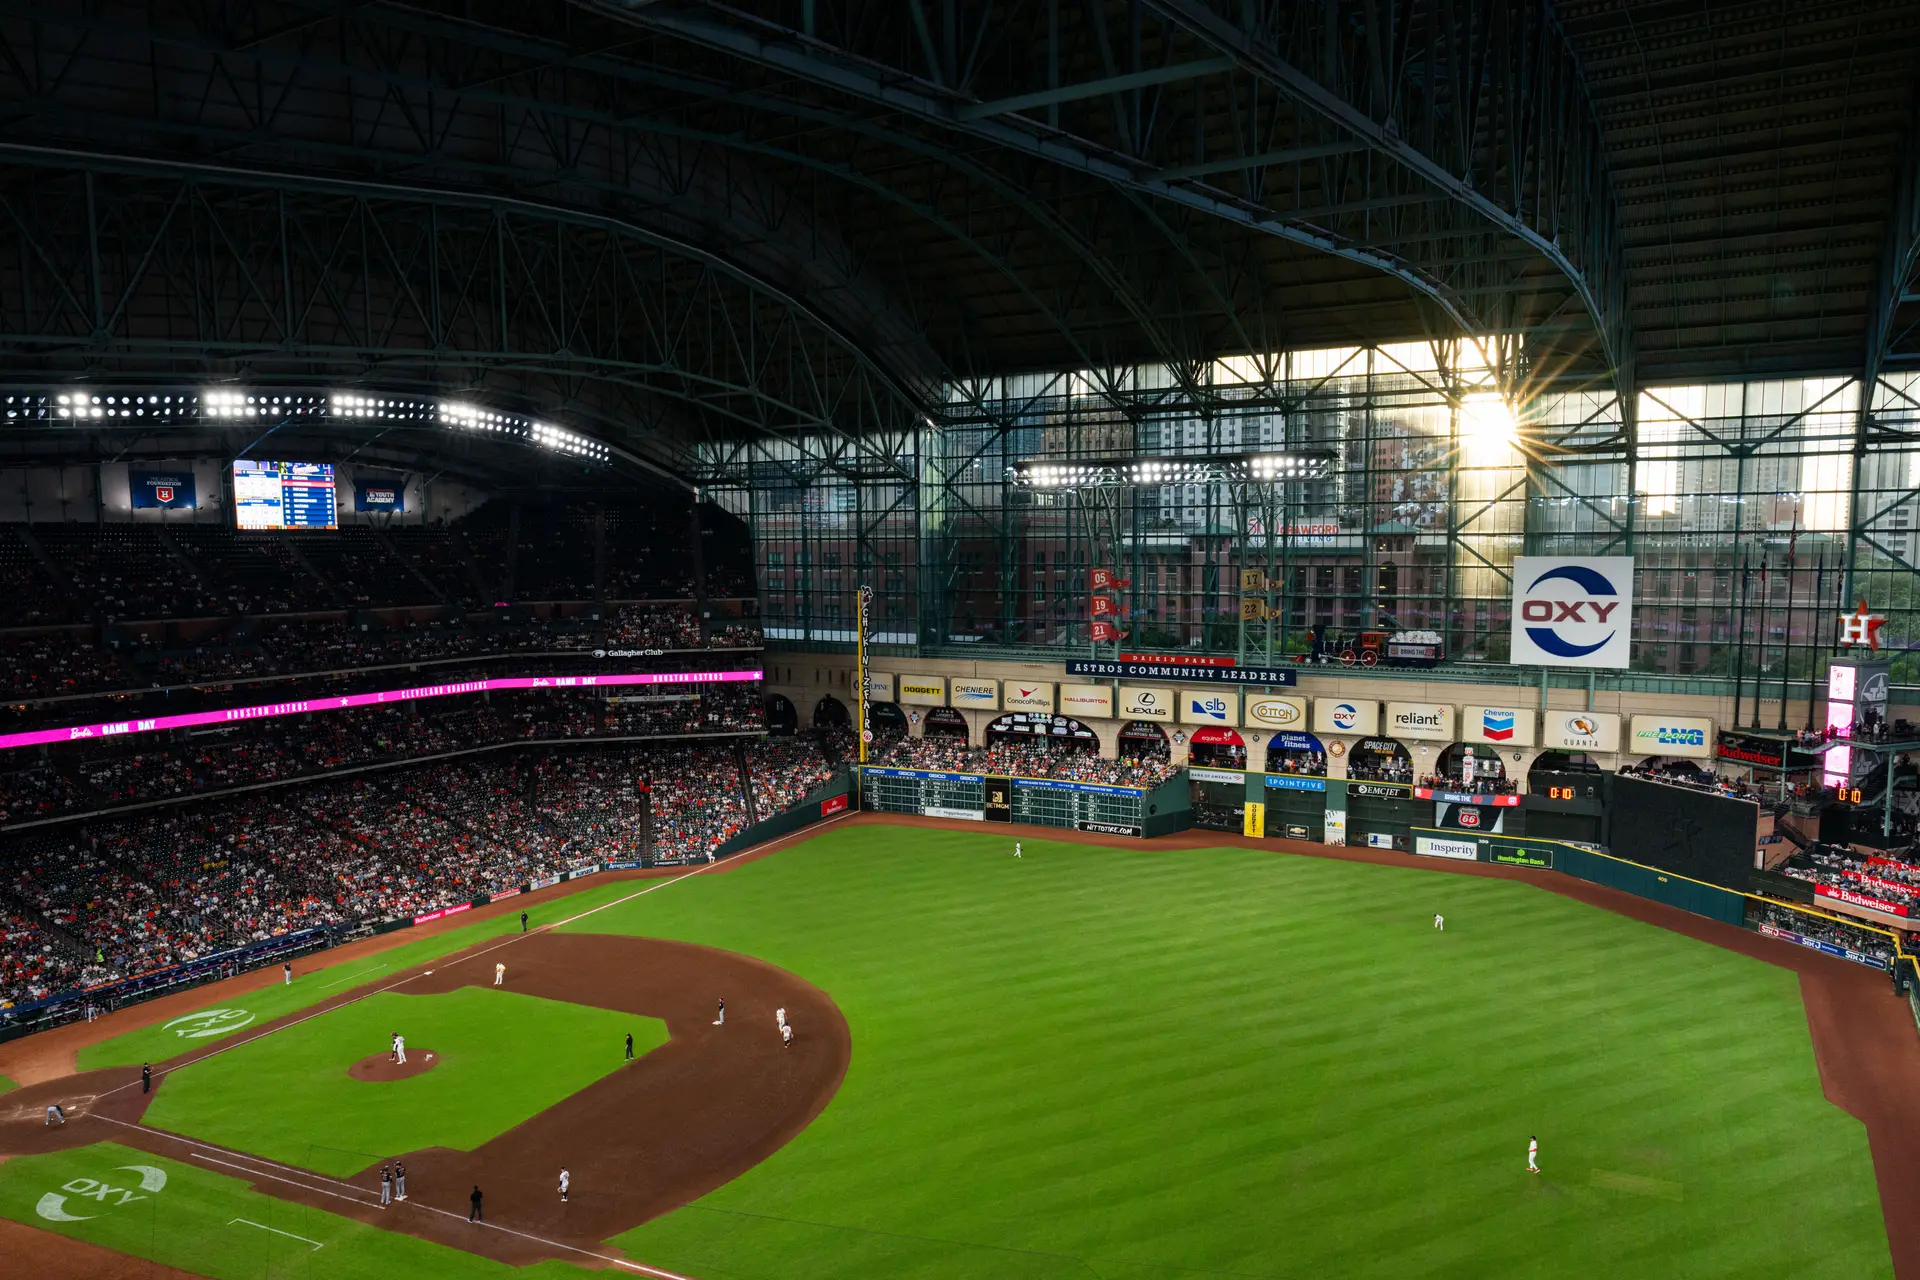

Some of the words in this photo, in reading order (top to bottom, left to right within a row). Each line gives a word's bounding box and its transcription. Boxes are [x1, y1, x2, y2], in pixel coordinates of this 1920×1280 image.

[1094, 573, 1106, 583] 05
[1246, 574, 1258, 585] 17
[1095, 601, 1106, 610] 19
[1244, 604, 1257, 614] 22
[1522, 600, 1620, 623] OXY
[1094, 626, 1105, 635] 21
[1840, 613, 1872, 645] H
[1132, 655, 1176, 663] DAIKIN
[1184, 657, 1215, 665] PARK
[653, 674, 689, 683] HOUSTON
[693, 673, 724, 681] ASTROS
[1074, 663, 1123, 673] ASTROS
[1129, 666, 1215, 678] COMMUNITY
[1221, 670, 1286, 682] LEADERS
[582, 677, 597, 685] DAY
[401, 686, 443, 699] CLEVELAND
[446, 681, 487, 694] GUARDIANS
[904, 686, 941, 694] DOGGETT
[955, 685, 994, 694] CHENIERE
[1006, 697, 1051, 707] ConocoPhillips
[1205, 698, 1226, 712] slb
[226, 706, 269, 720] HOUSTON
[274, 702, 308, 715] ASTROS
[1126, 706, 1166, 716] LEXUS
[1257, 706, 1293, 720] COTTON
[1484, 709, 1514, 717] Chevron
[1396, 712, 1440, 726] reliant
[70, 727, 94, 739] Barbie
[102, 723, 129, 735] GAME
[138, 720, 156, 731] DAY
[1636, 730, 1695, 740] FREEPORT
[1281, 734, 1306, 742] planet
[1658, 728, 1704, 746] LNG
[1284, 741, 1310, 749] fitness
[1364, 740, 1384, 750] SPACE
[1382, 742, 1398, 752] CITY
[1564, 738, 1599, 748] QUANTA
[1717, 744, 1781, 766] Budweiser
[1269, 779, 1322, 788] 1POINTFIVE
[1366, 786, 1400, 796] EMCJET
[1550, 788, 1572, 800] 0:10
[1838, 788, 1860, 804] 0:10
[1444, 794, 1460, 802] BRING
[986, 802, 1010, 810] BETMGM
[1462, 814, 1476, 824] 66
[1086, 824, 1132, 836] NITTOTIRE.COM
[1430, 842, 1474, 856] Insperity
[1498, 855, 1530, 865] Huntington
[1530, 858, 1545, 866] Bank
[1841, 890, 1896, 914] Budweiser
[445, 904, 471, 916] Budweiser
[415, 912, 441, 924] Budweiser
[1802, 937, 1816, 948] Six
[1845, 950, 1859, 960] Six
[61, 1178, 148, 1206] OXY
